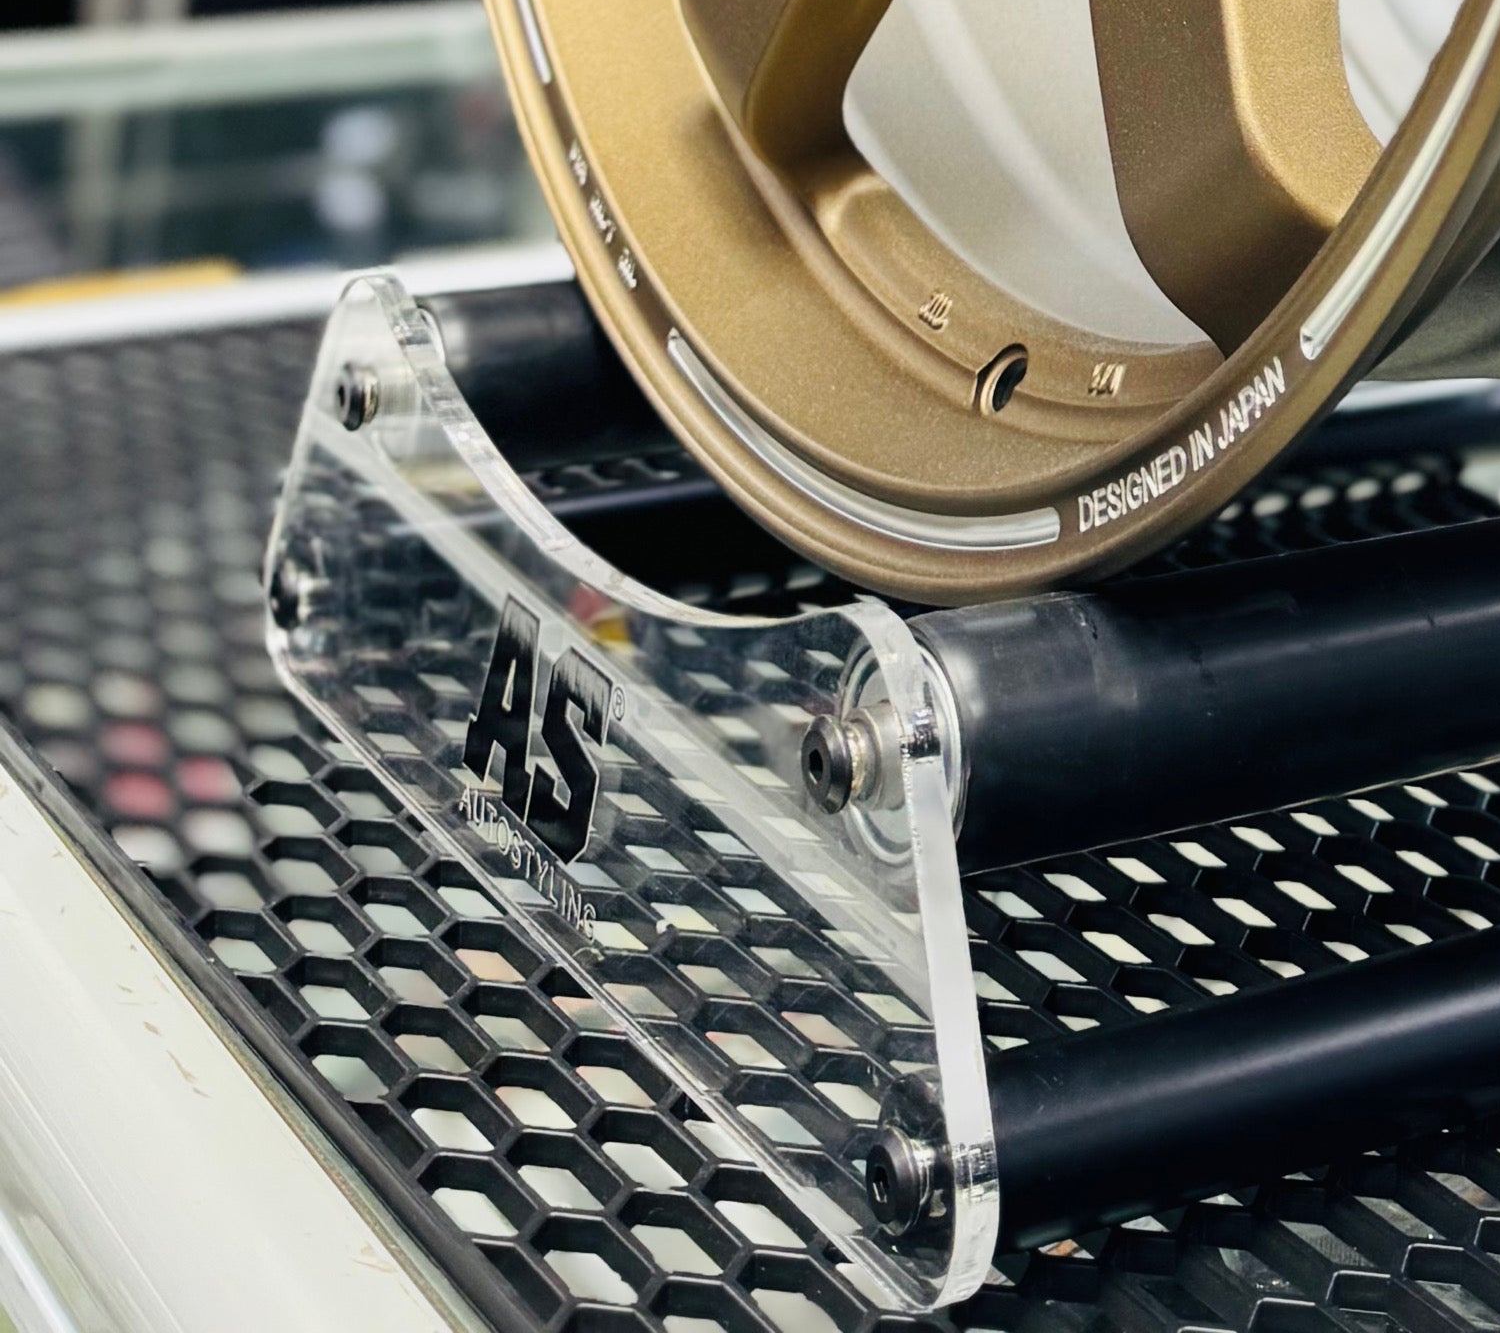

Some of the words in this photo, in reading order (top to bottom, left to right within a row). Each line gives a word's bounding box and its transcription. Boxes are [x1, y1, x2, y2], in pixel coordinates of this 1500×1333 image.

[1078, 445, 1187, 533] DESIGNED
[1188, 423, 1215, 471] IN
[1218, 356, 1286, 449] JAPAN
[458, 785, 597, 944] AUTOSTYLING
